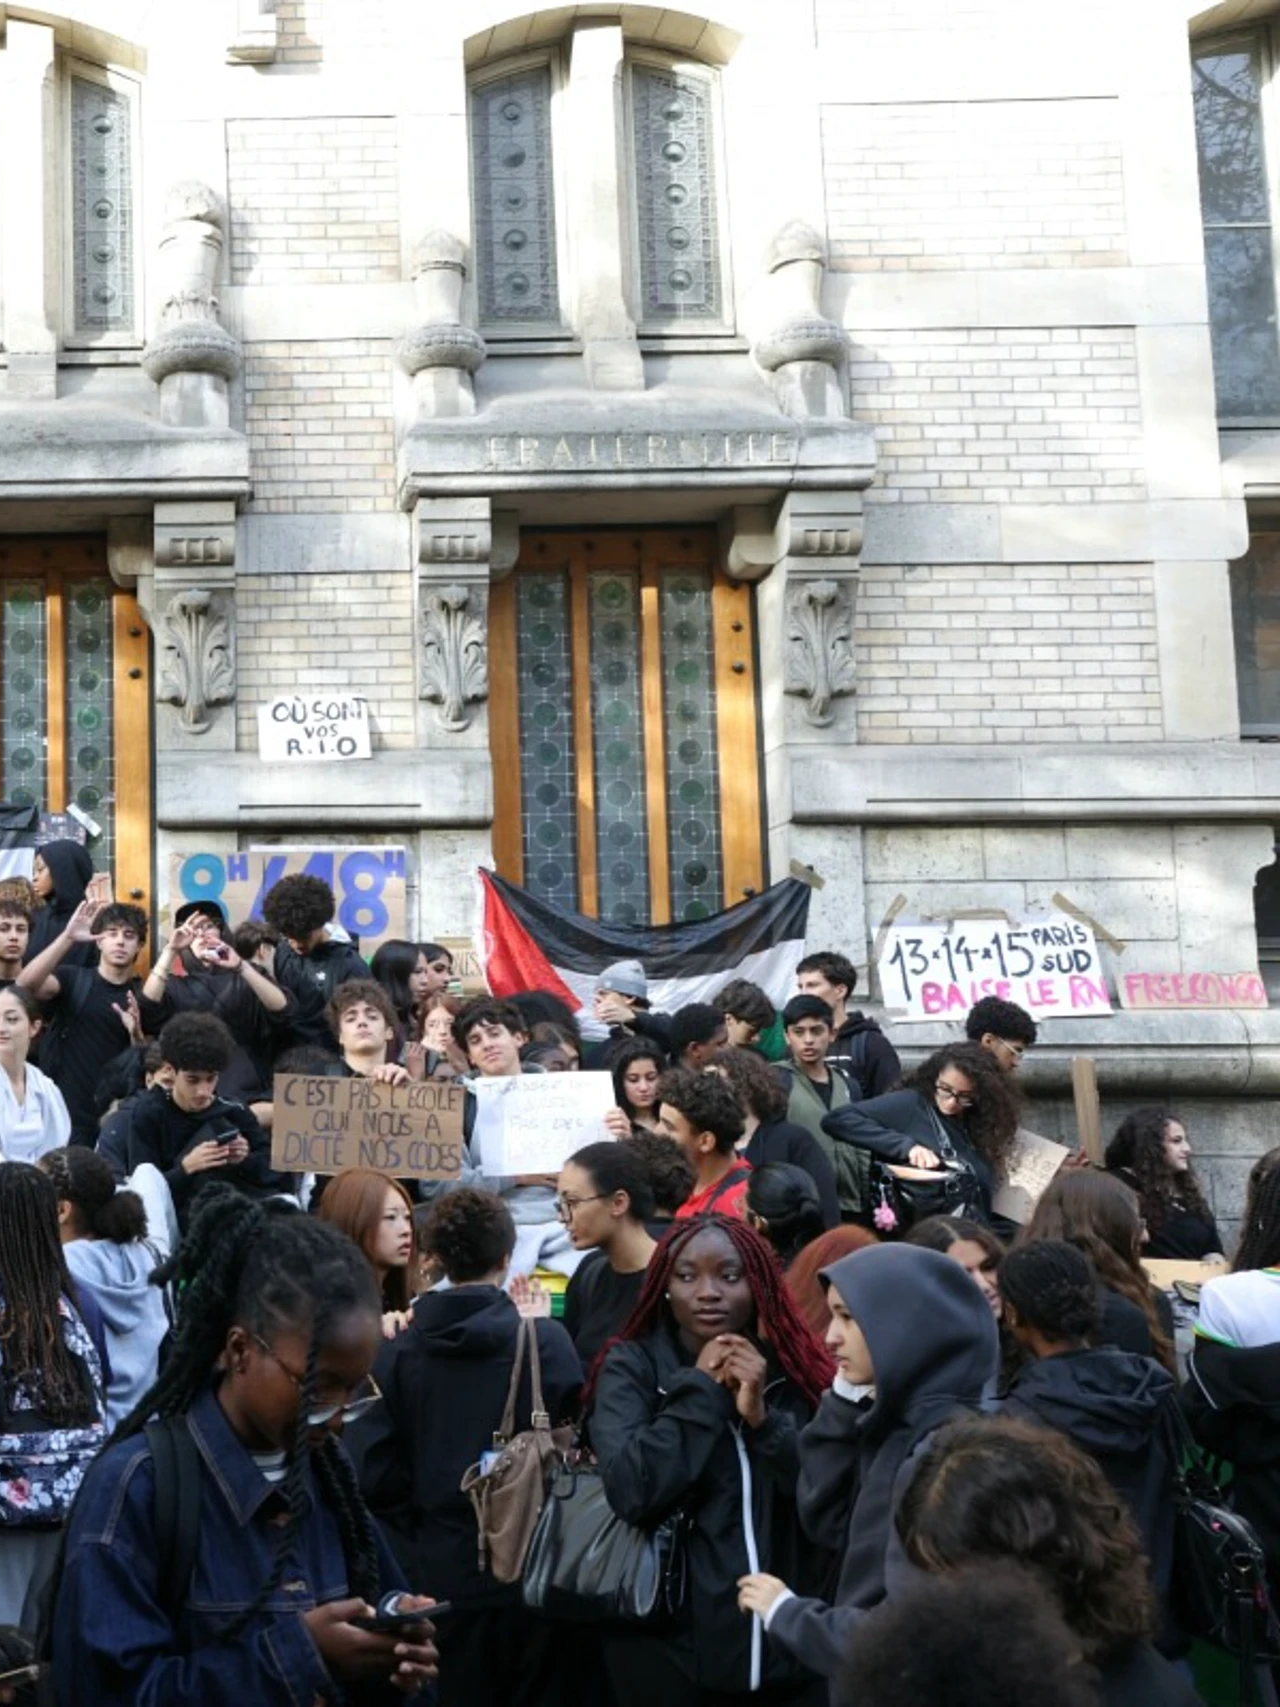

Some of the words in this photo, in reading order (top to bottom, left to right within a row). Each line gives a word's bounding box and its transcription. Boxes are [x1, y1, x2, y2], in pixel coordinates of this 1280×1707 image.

[312, 697, 368, 721] SONT
[1041, 949, 1092, 974] SUD
[1026, 978, 1059, 1008] LE
[1070, 974, 1111, 1009] RN
[284, 1078, 341, 1107] C'EST
[349, 1080, 381, 1111] PAS
[312, 1109, 350, 1133] QUI
[363, 1111, 414, 1137] NOUS
[358, 1138, 401, 1169] NOS
[407, 1140, 462, 1172] CODES
